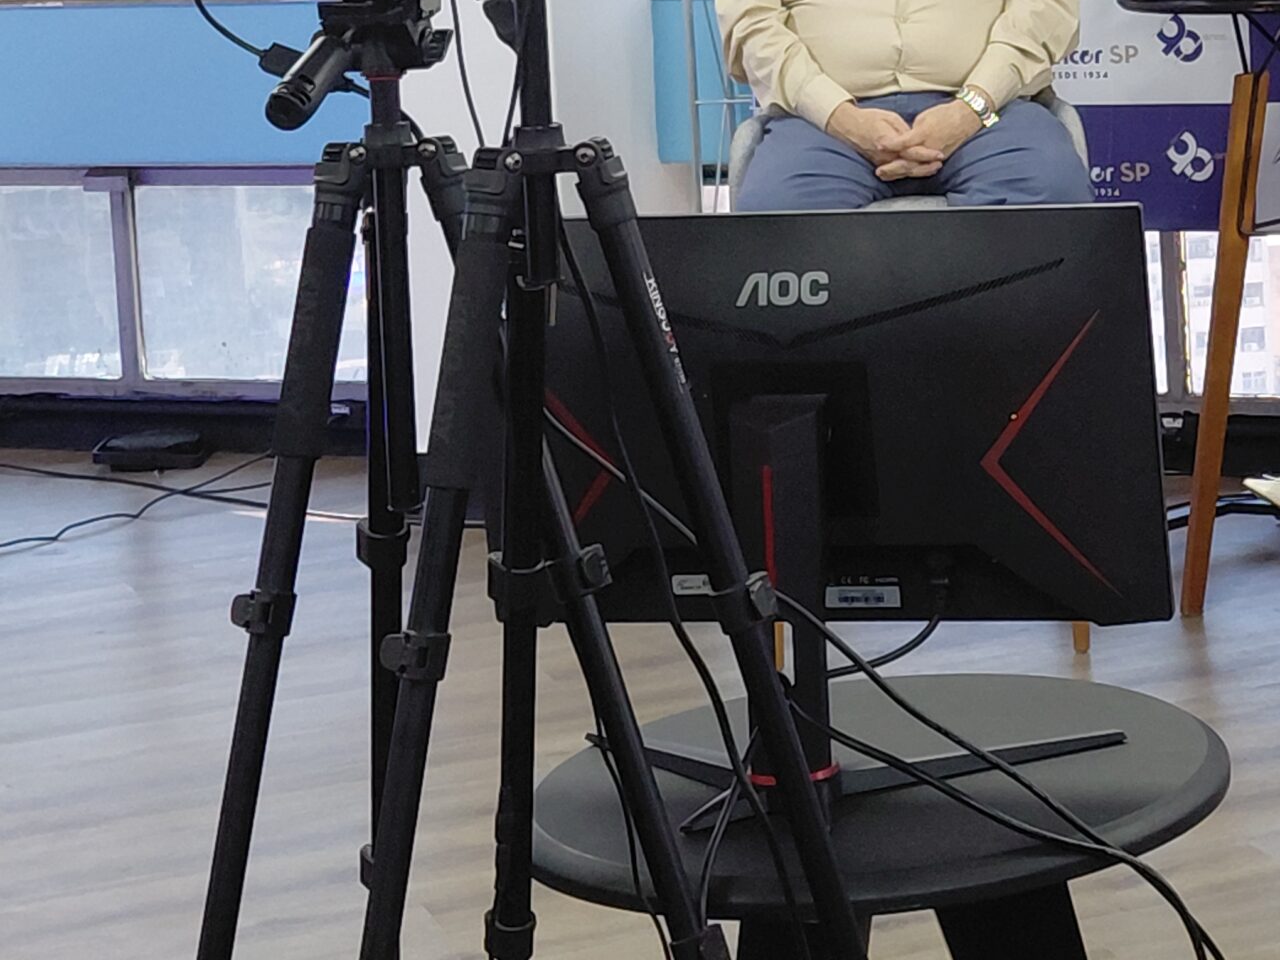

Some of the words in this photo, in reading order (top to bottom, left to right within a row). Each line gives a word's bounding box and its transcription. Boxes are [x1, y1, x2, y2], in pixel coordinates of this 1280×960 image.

[1064, 49, 1103, 65] cor
[1110, 45, 1139, 64] SP
[1083, 71, 1108, 79] 1934
[1166, 131, 1214, 182] 90
[1120, 162, 1150, 182] SP
[735, 270, 830, 308] AOC
